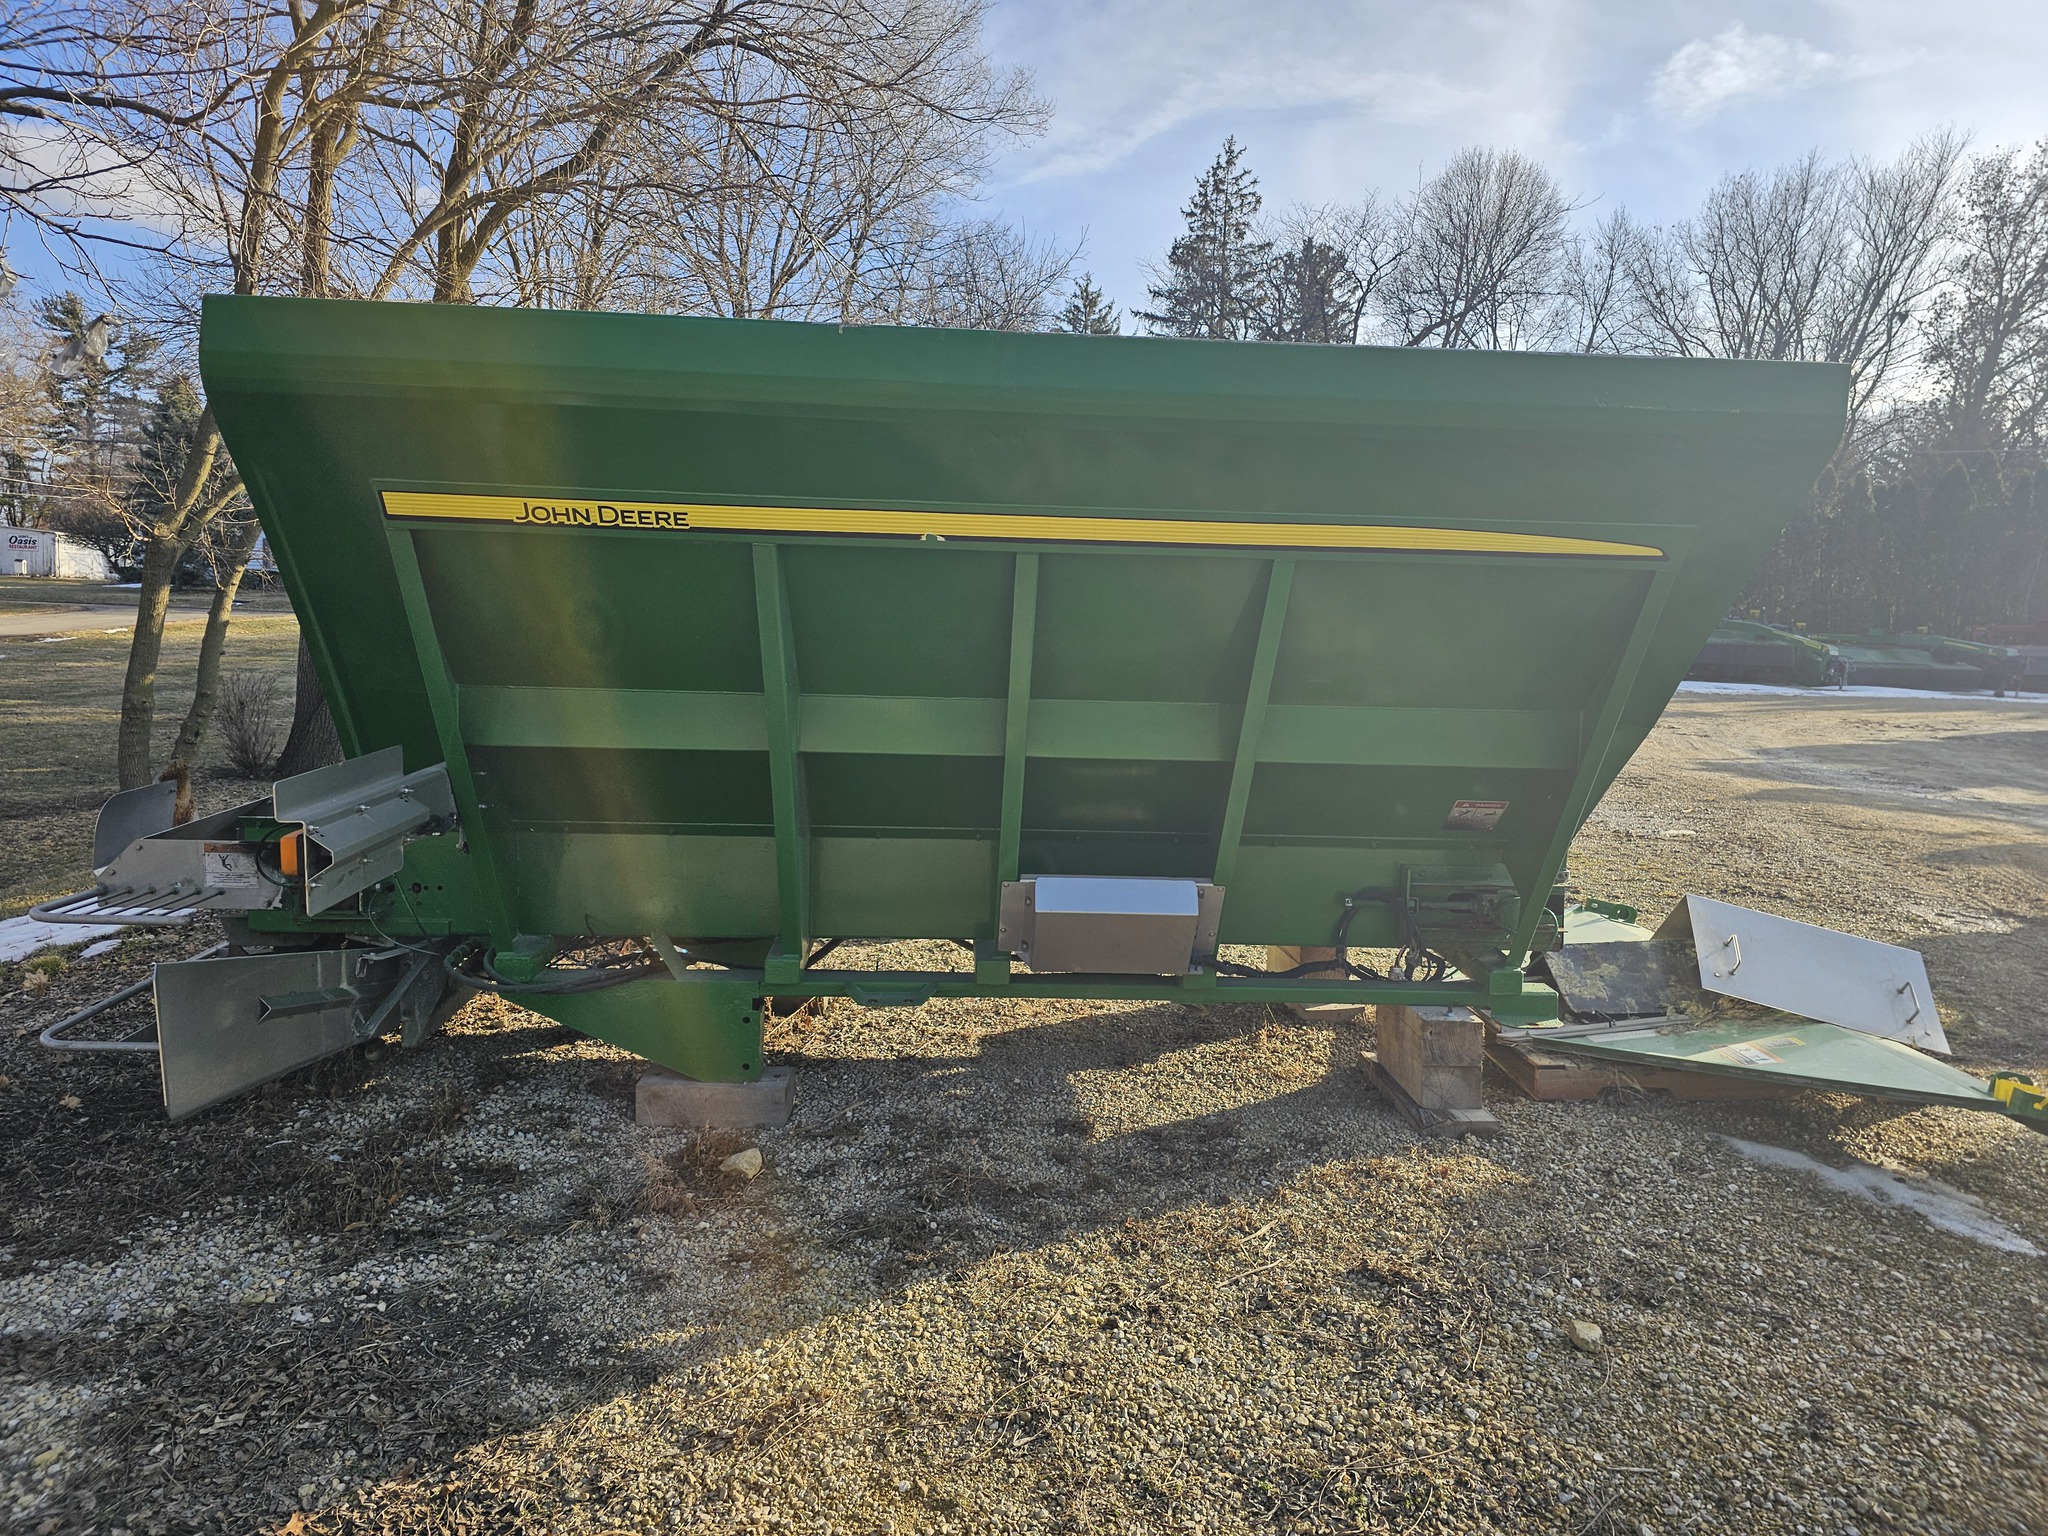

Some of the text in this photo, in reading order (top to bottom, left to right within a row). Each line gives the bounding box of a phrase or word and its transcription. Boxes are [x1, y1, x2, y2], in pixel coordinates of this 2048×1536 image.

[515, 502, 690, 527] JOHN DEERE
[9, 535, 37, 545] Oasis
